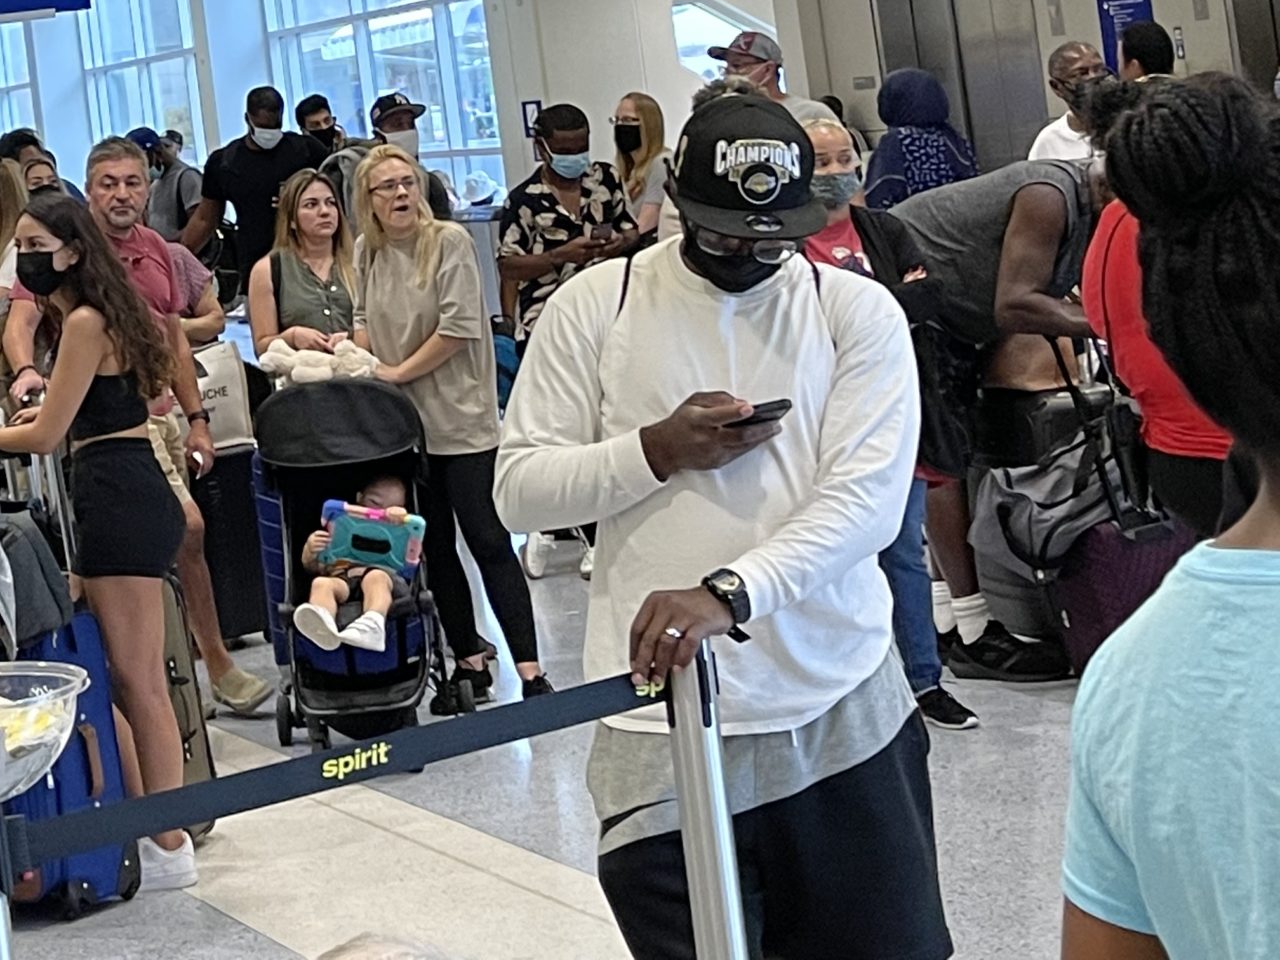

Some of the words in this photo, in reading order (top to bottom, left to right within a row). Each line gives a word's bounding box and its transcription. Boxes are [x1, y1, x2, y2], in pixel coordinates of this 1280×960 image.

[714, 139, 800, 179] CHAMPIONS
[200, 385, 229, 401] UCHE
[322, 742, 390, 779] spirit
